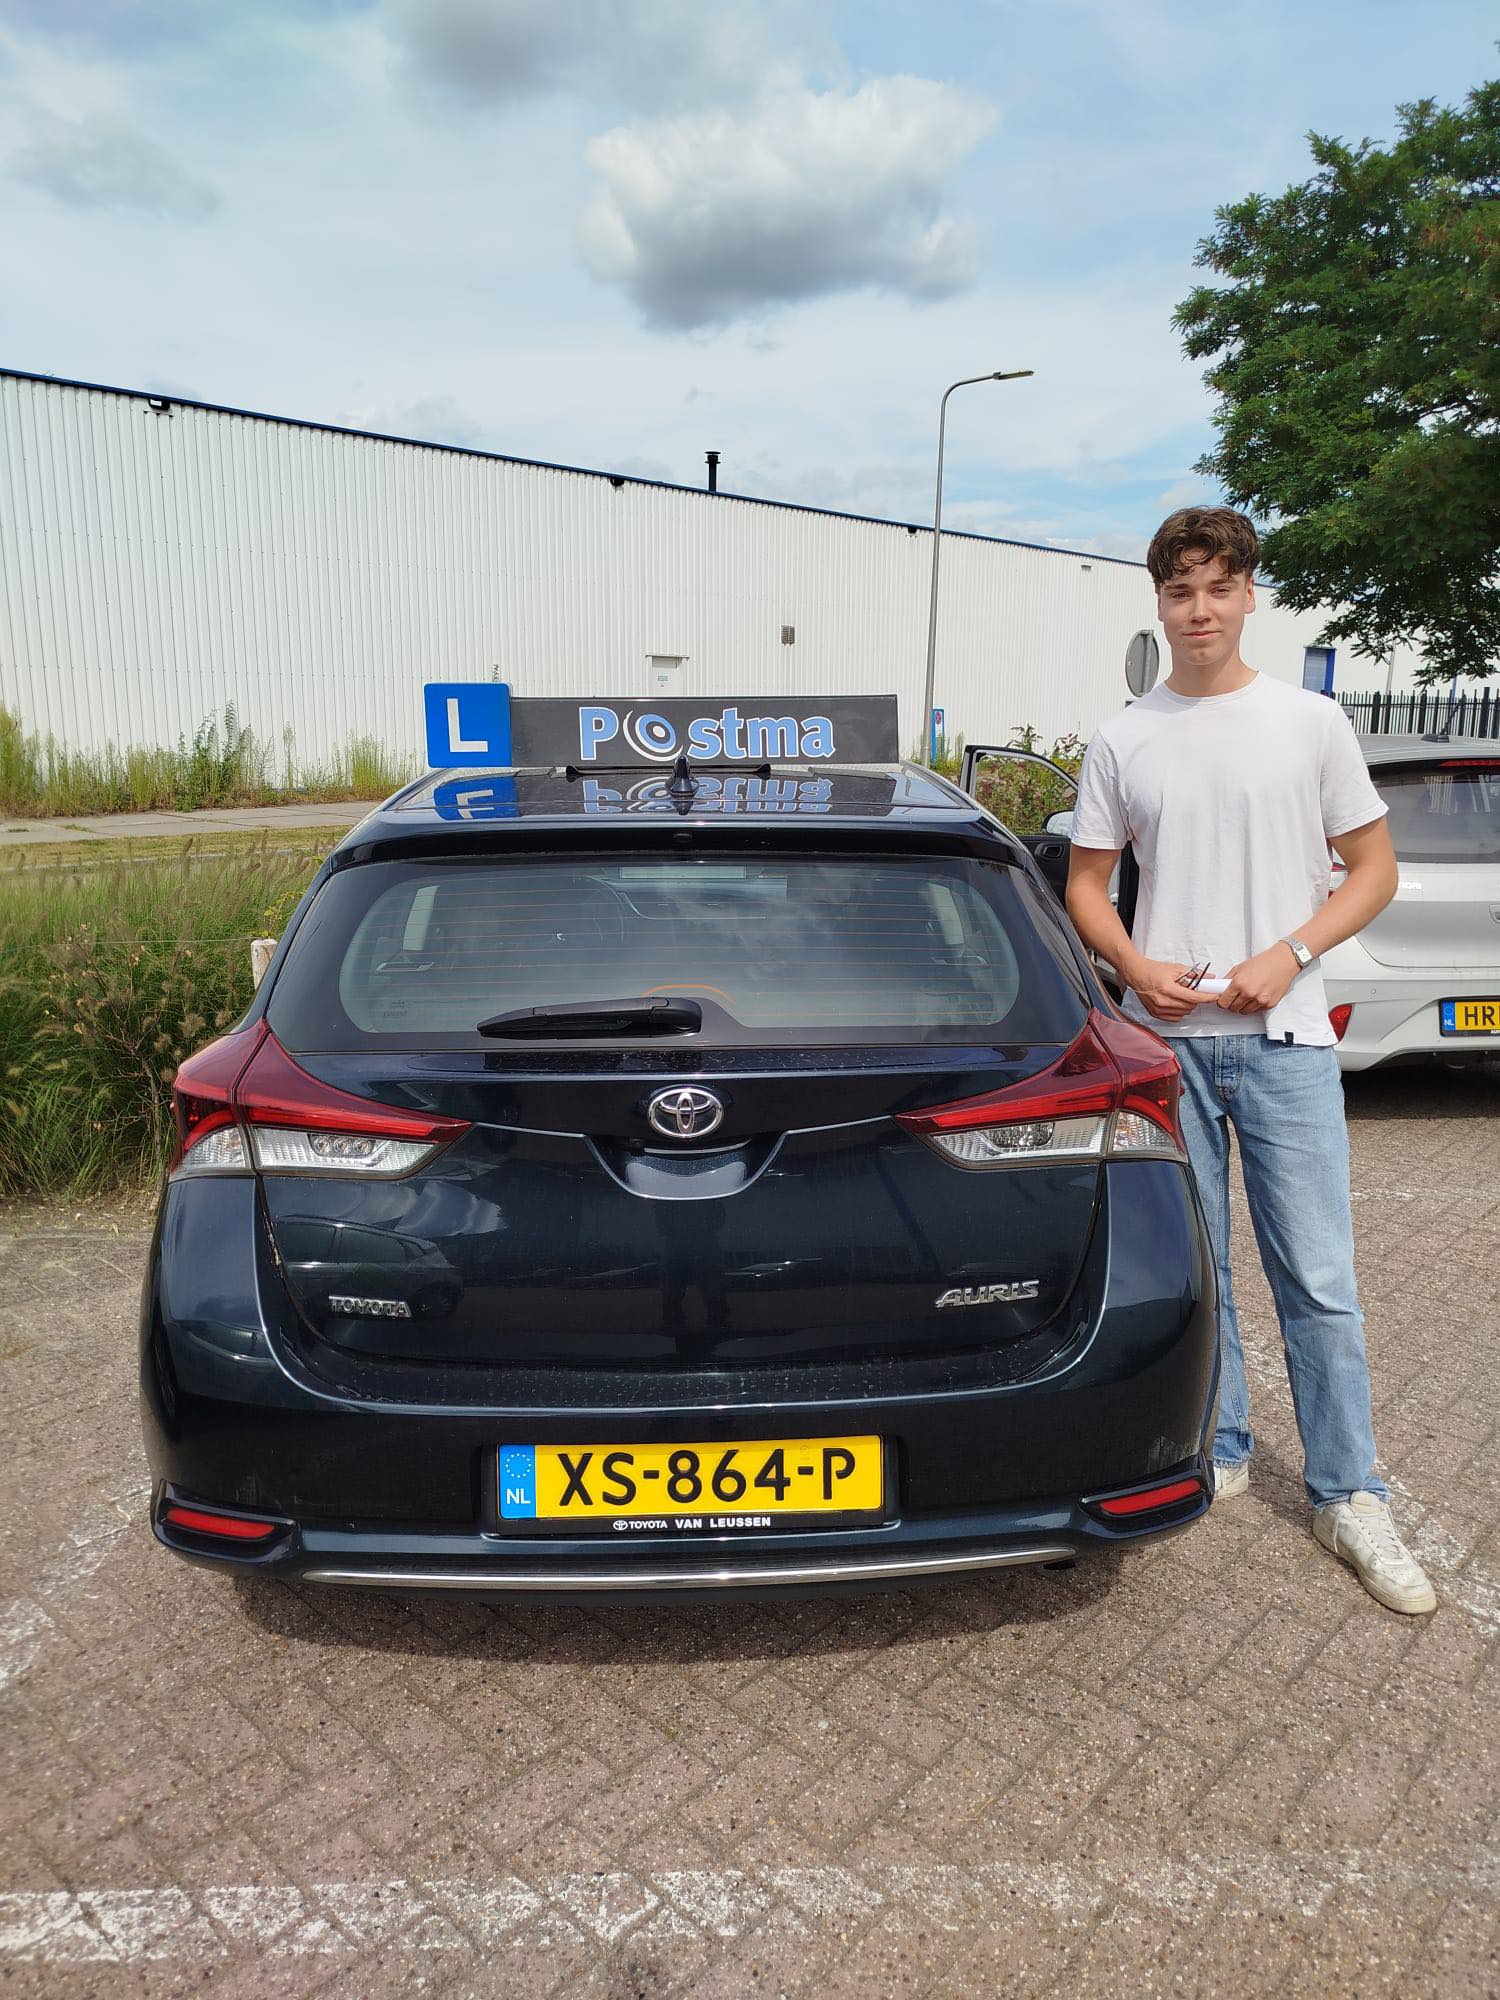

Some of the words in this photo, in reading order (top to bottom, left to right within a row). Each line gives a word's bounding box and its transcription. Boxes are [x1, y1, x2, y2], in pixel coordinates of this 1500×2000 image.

[447, 698, 489, 753] L
[579, 706, 837, 762] Postma
[1464, 1005, 1500, 1027] HR
[328, 1295, 412, 1318] TOYOTA
[935, 1280, 1039, 1308] AURIS
[557, 1447, 856, 1507] XS-864-P
[506, 1488, 531, 1505] NL
[629, 1520, 668, 1529] TOYOTA
[675, 1518, 703, 1529] VAN
[709, 1516, 771, 1528] LEUSSEN
